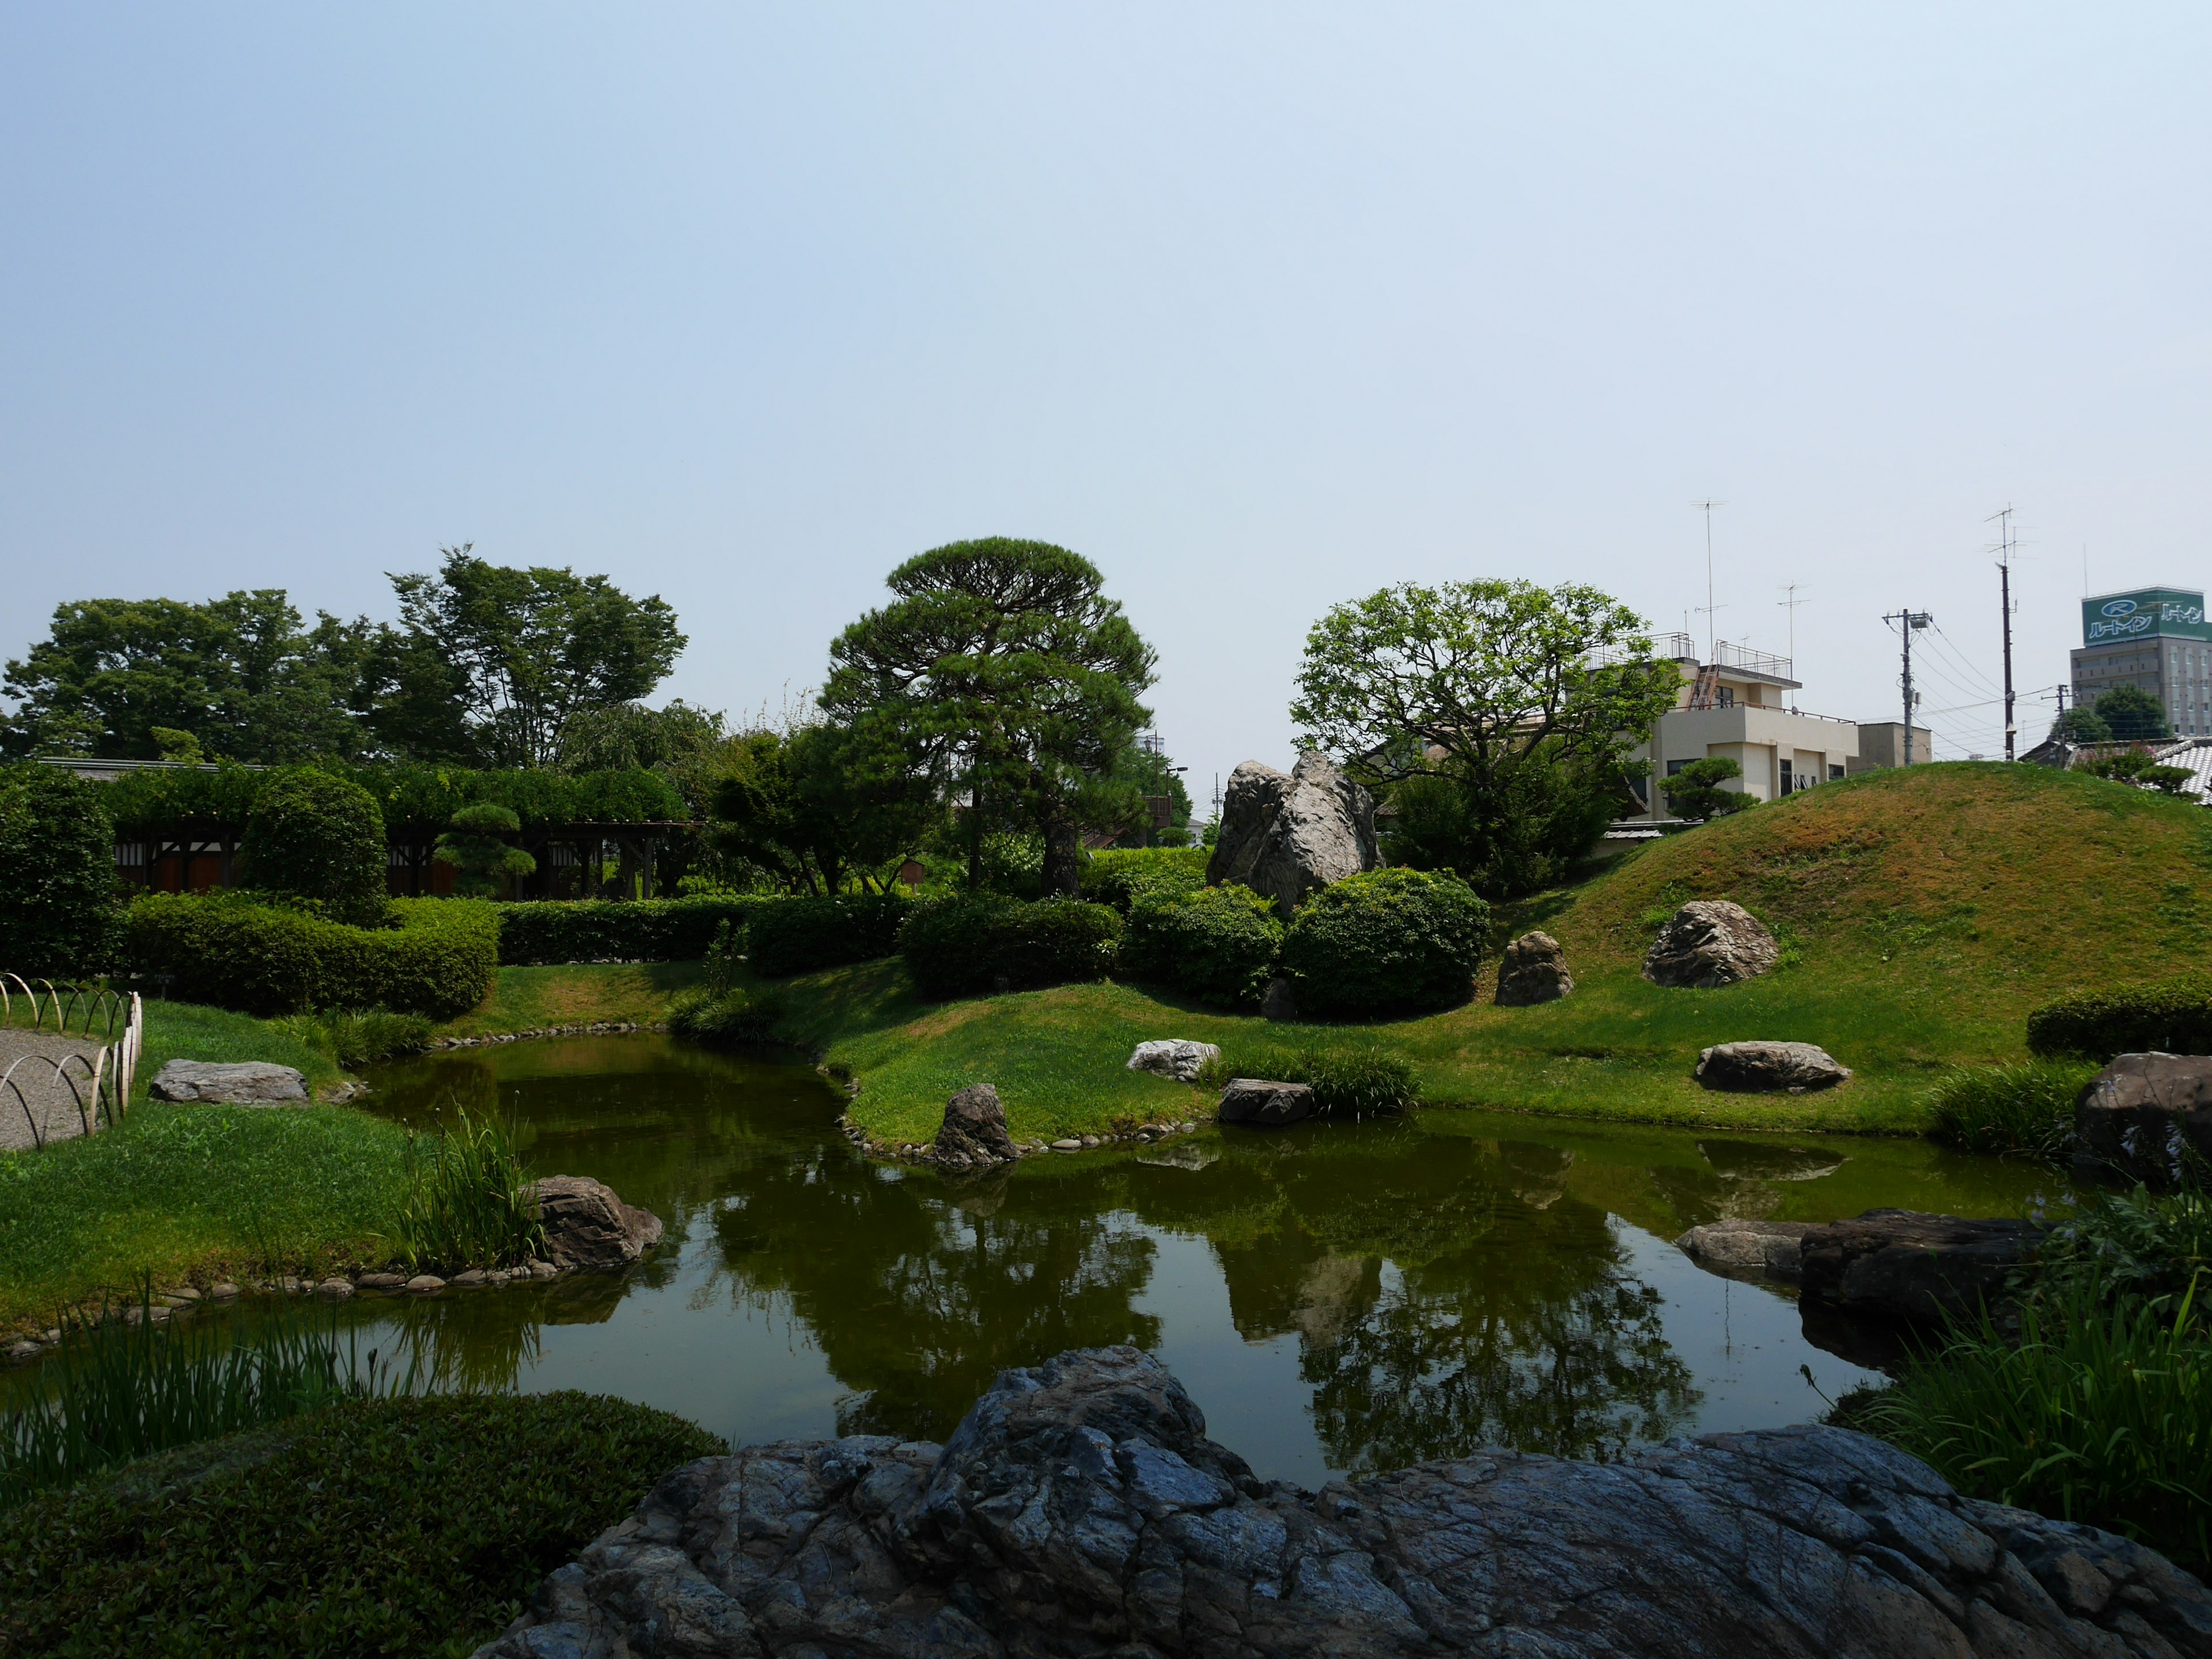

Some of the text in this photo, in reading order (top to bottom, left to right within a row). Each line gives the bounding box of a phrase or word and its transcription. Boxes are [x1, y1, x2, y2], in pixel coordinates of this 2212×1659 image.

[2161, 603, 2202, 624] ルートイン
[2089, 616, 2152, 639] ルートイン
